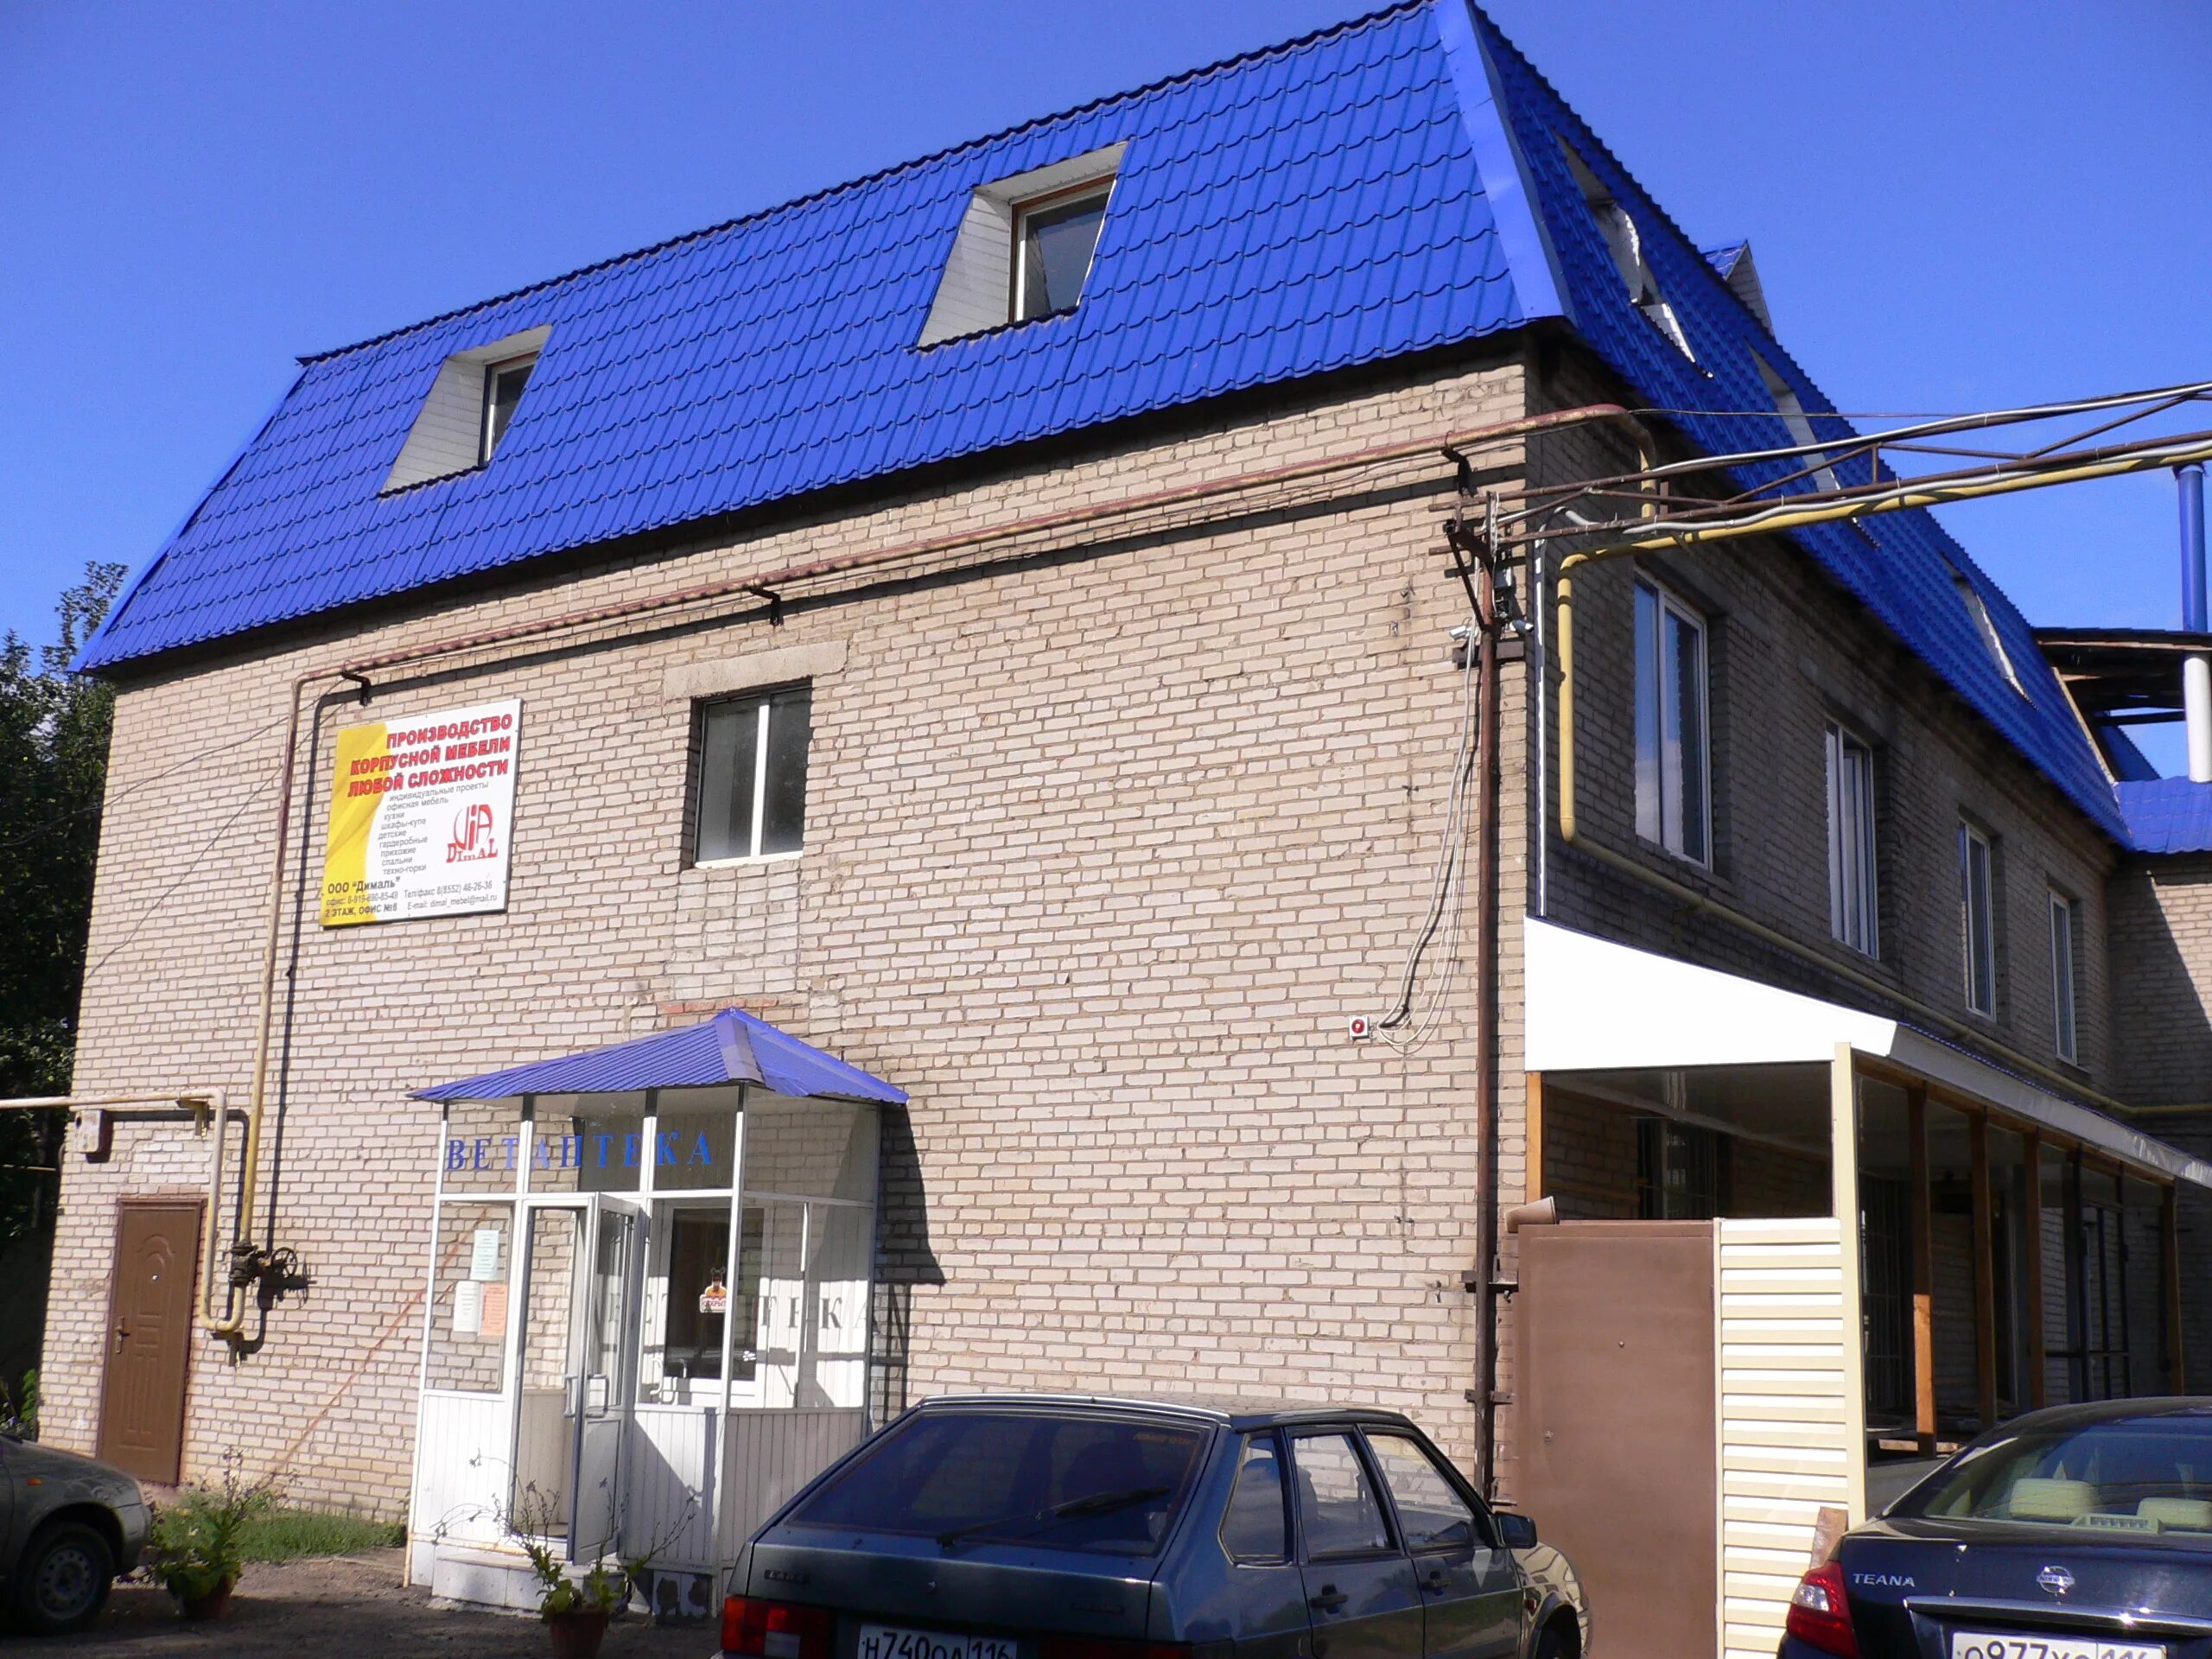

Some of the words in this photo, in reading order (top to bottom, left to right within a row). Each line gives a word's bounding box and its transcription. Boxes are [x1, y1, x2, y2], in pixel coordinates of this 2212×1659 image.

[386, 713, 512, 749] ПРОИЗВОДСТВО
[350, 746, 441, 776] КОРПУСНОЙ
[445, 735, 511, 761] МЕБЕЛИ
[347, 772, 404, 798] ЛЮБОЙ
[408, 759, 509, 788] СЛОЖНОСТИ
[389, 786, 454, 802] индивидуальные
[456, 782, 489, 793] проекты
[386, 800, 419, 812] офисная
[421, 796, 448, 806] мебель
[384, 812, 405, 822] кухни
[381, 818, 427, 830] шкафы-купе
[378, 830, 407, 841] детские
[379, 836, 429, 849] гардеробные
[380, 847, 416, 858] прихожие
[381, 857, 413, 866] спальни
[383, 864, 427, 875] техно-горки
[327, 881, 350, 894] ООО
[324, 909, 331, 918] 2
[359, 904, 382, 915] ОФИС
[1853, 1573, 1916, 1588] TEANA
